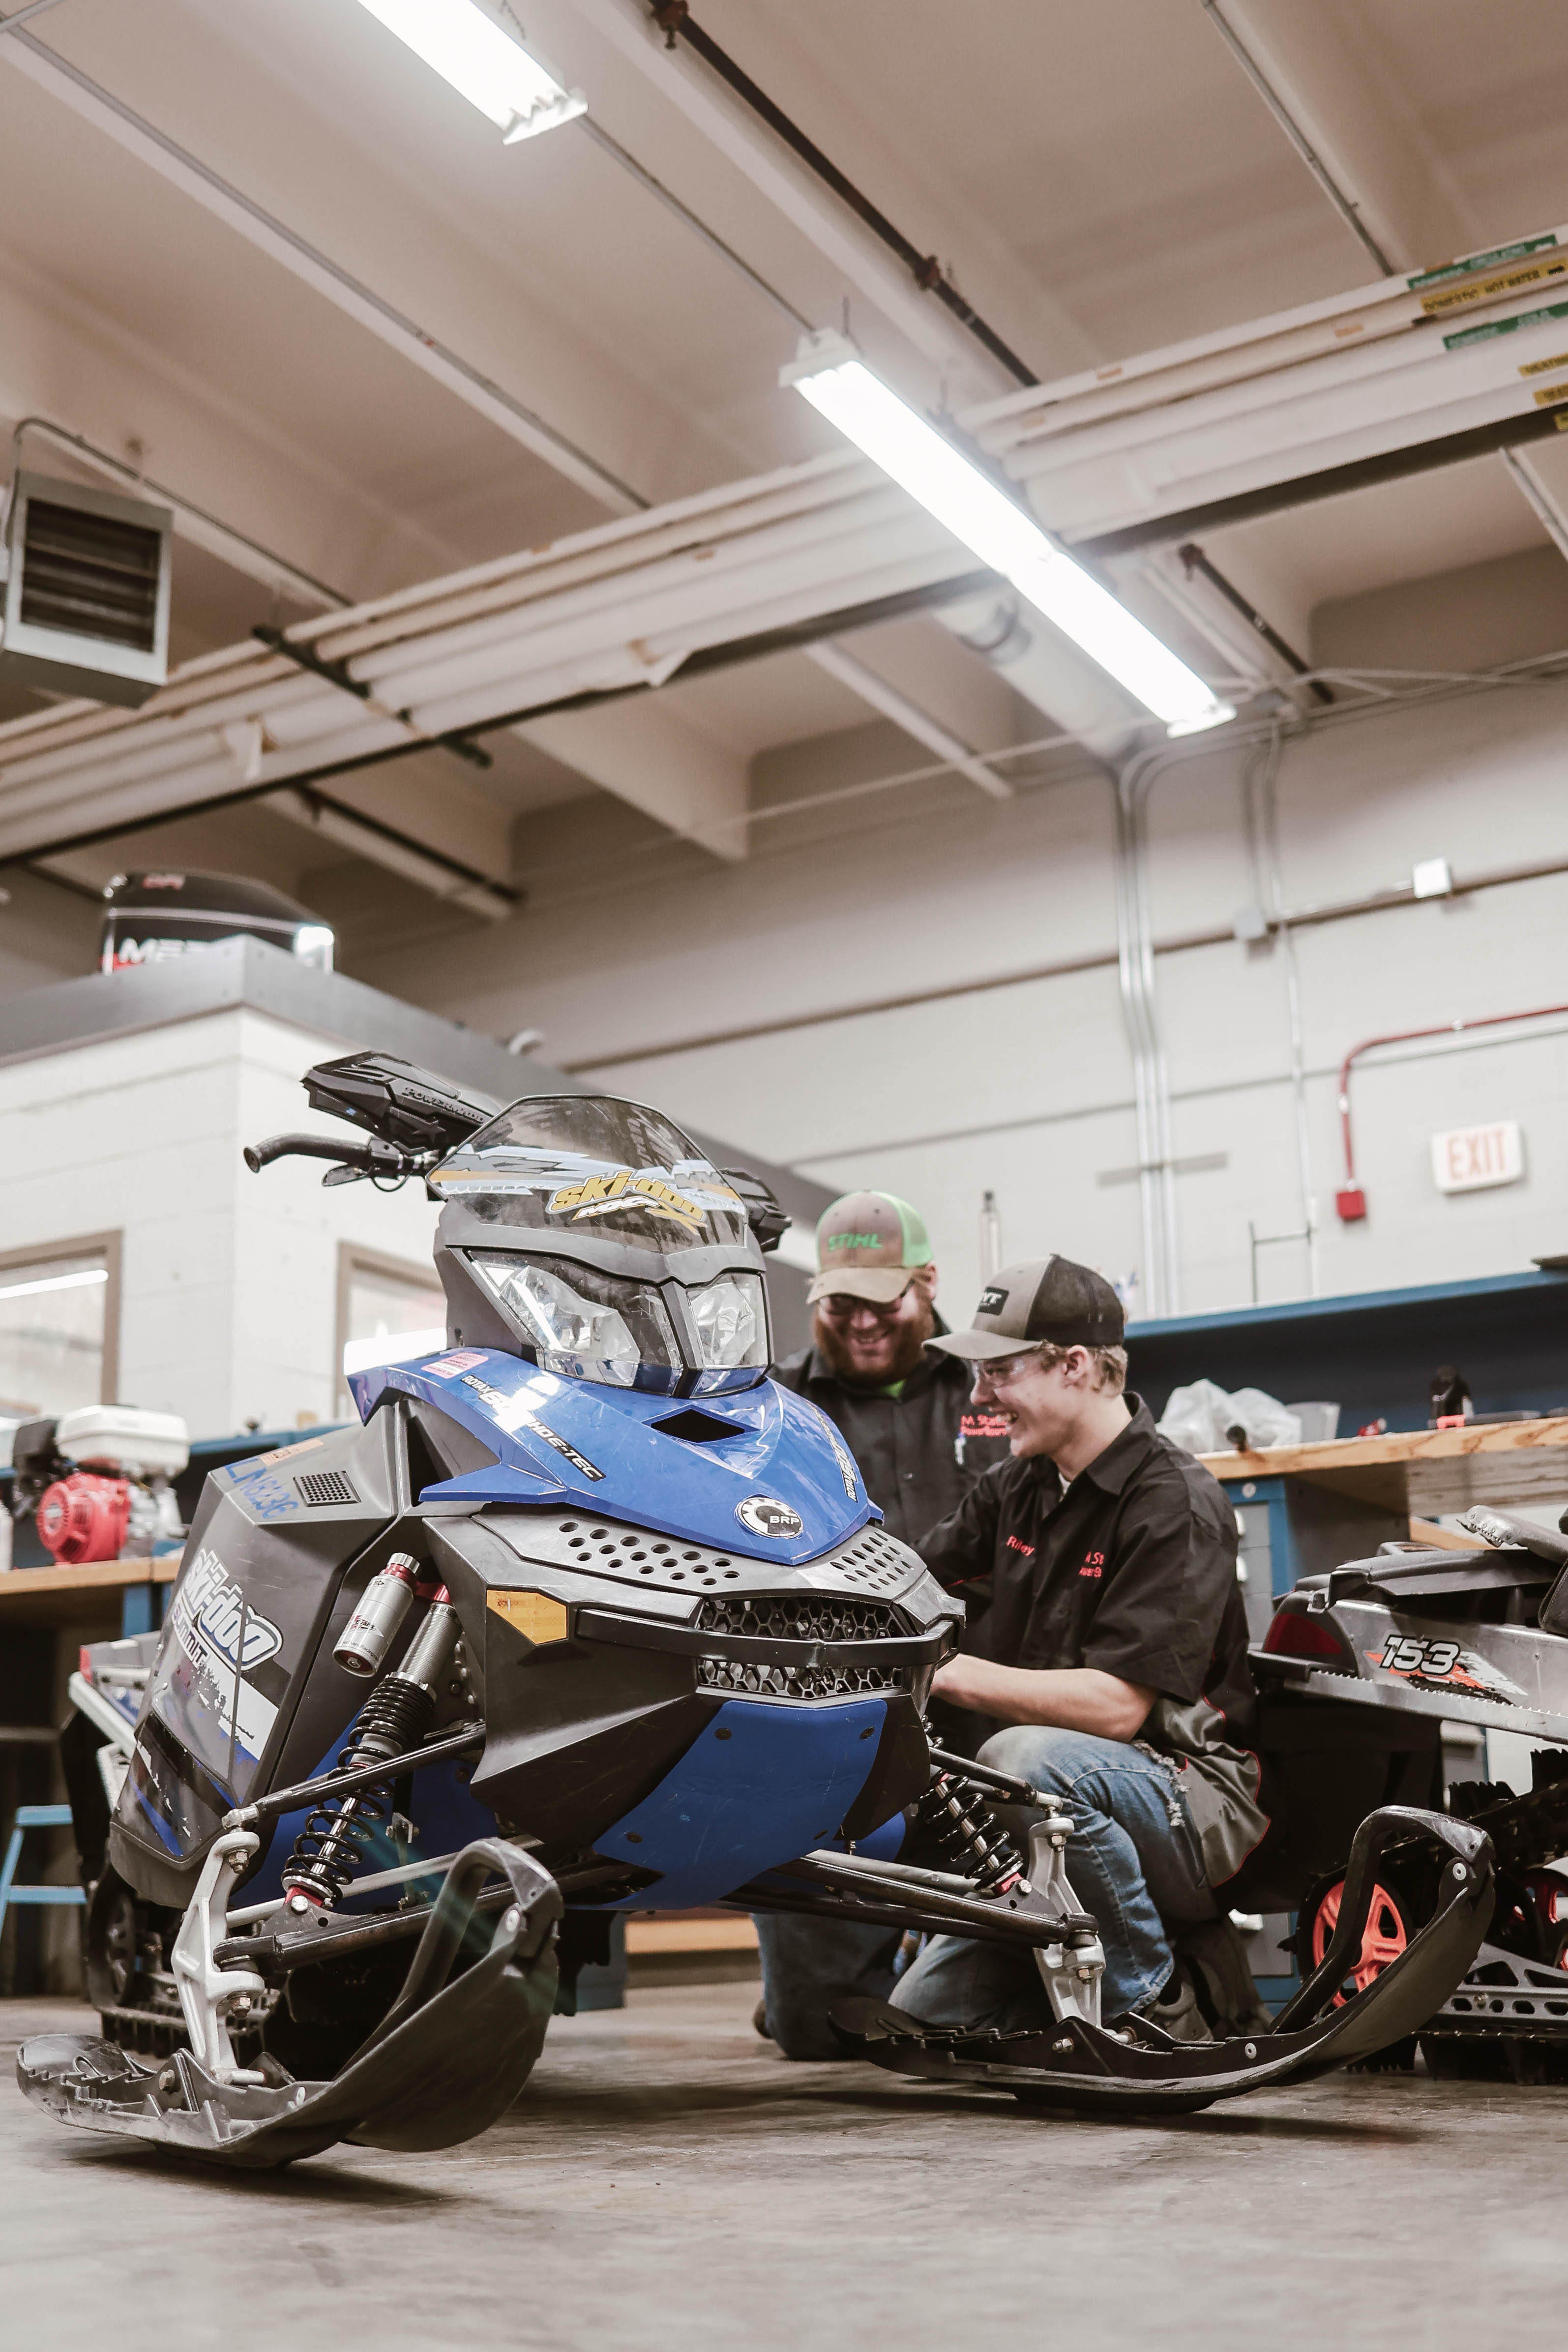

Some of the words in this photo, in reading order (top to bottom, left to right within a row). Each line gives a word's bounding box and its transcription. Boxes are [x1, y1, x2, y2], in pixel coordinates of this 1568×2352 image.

[1446, 1126, 1507, 1181] EXIT
[828, 1233, 883, 1251] STIHL
[462, 1375, 493, 1394] ROTAX
[547, 1437, 603, 1479] E-TEC
[961, 1415, 975, 1426] M
[843, 1472, 857, 1502] ROTAX
[769, 1515, 800, 1524] BRP
[1006, 1535, 1035, 1557] Riley
[1381, 1636, 1460, 1675] 153
